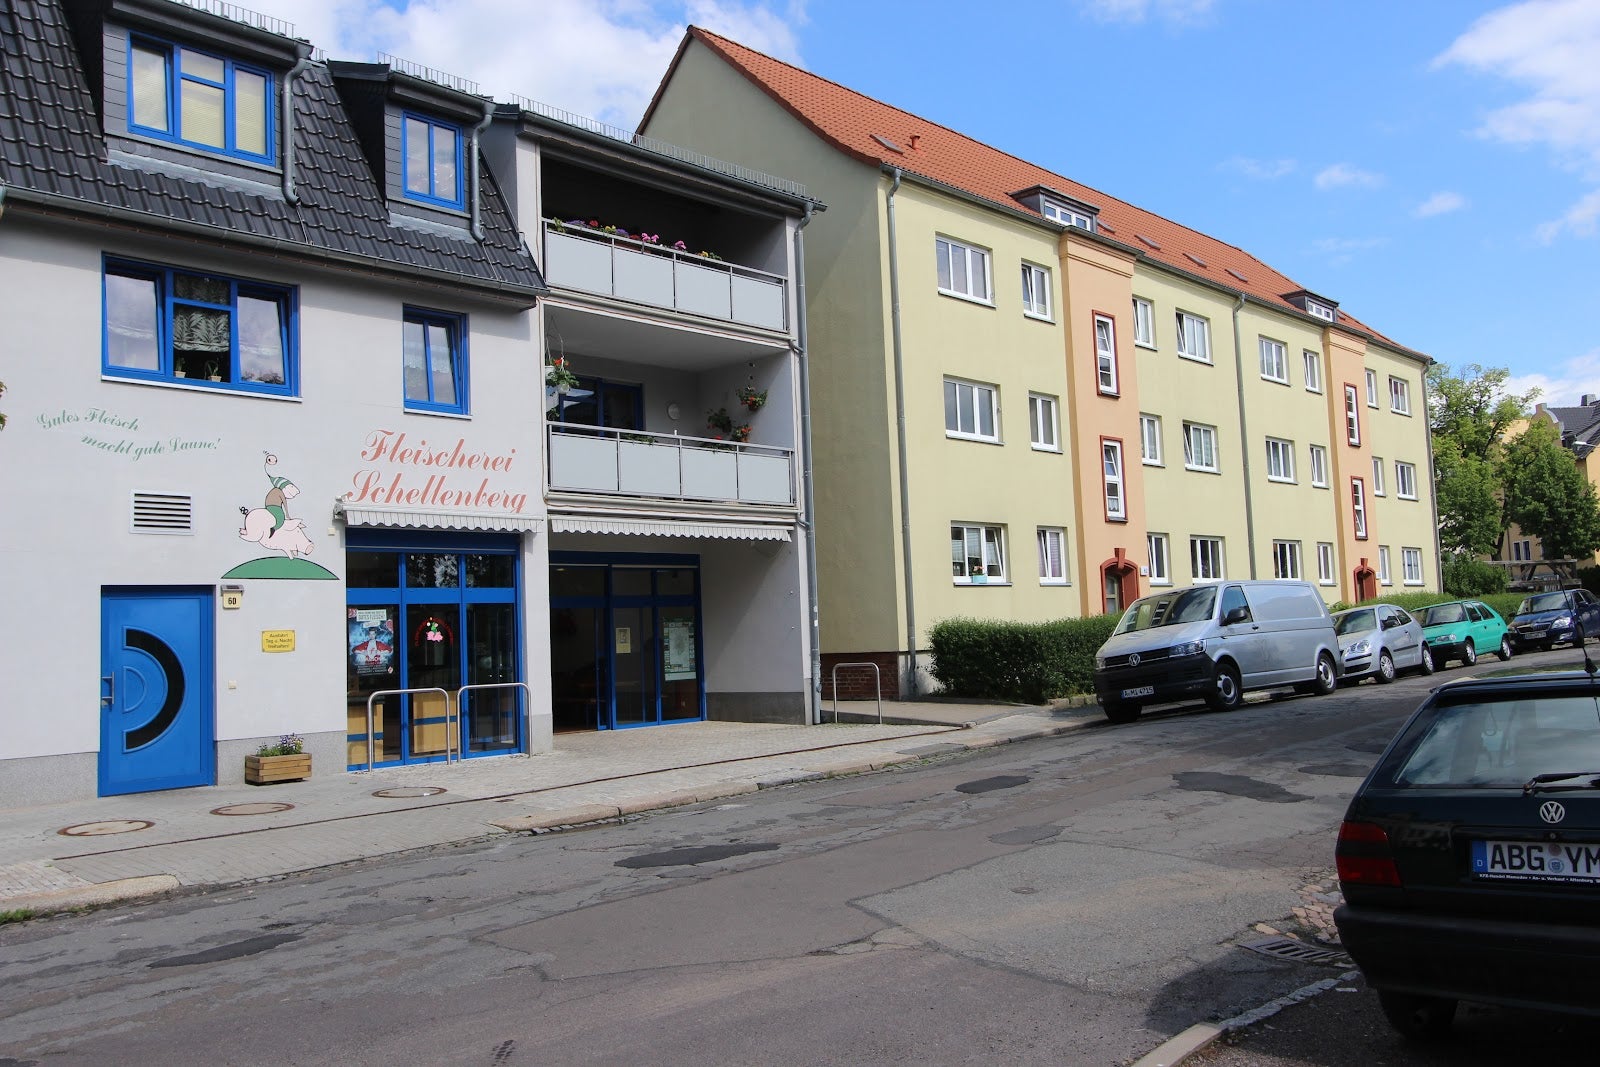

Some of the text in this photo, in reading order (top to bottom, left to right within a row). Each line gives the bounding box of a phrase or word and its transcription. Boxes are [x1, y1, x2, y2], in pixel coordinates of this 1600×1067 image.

[36, 407, 139, 432] Gutes Fleisch
[80, 433, 222, 462] macht gute Laune!
[360, 429, 517, 473] Fleischerei
[346, 469, 528, 514] Schellenberg
[228, 597, 237, 605] 60
[1490, 843, 1545, 872] ABG
[1565, 846, 1600, 874] YM
